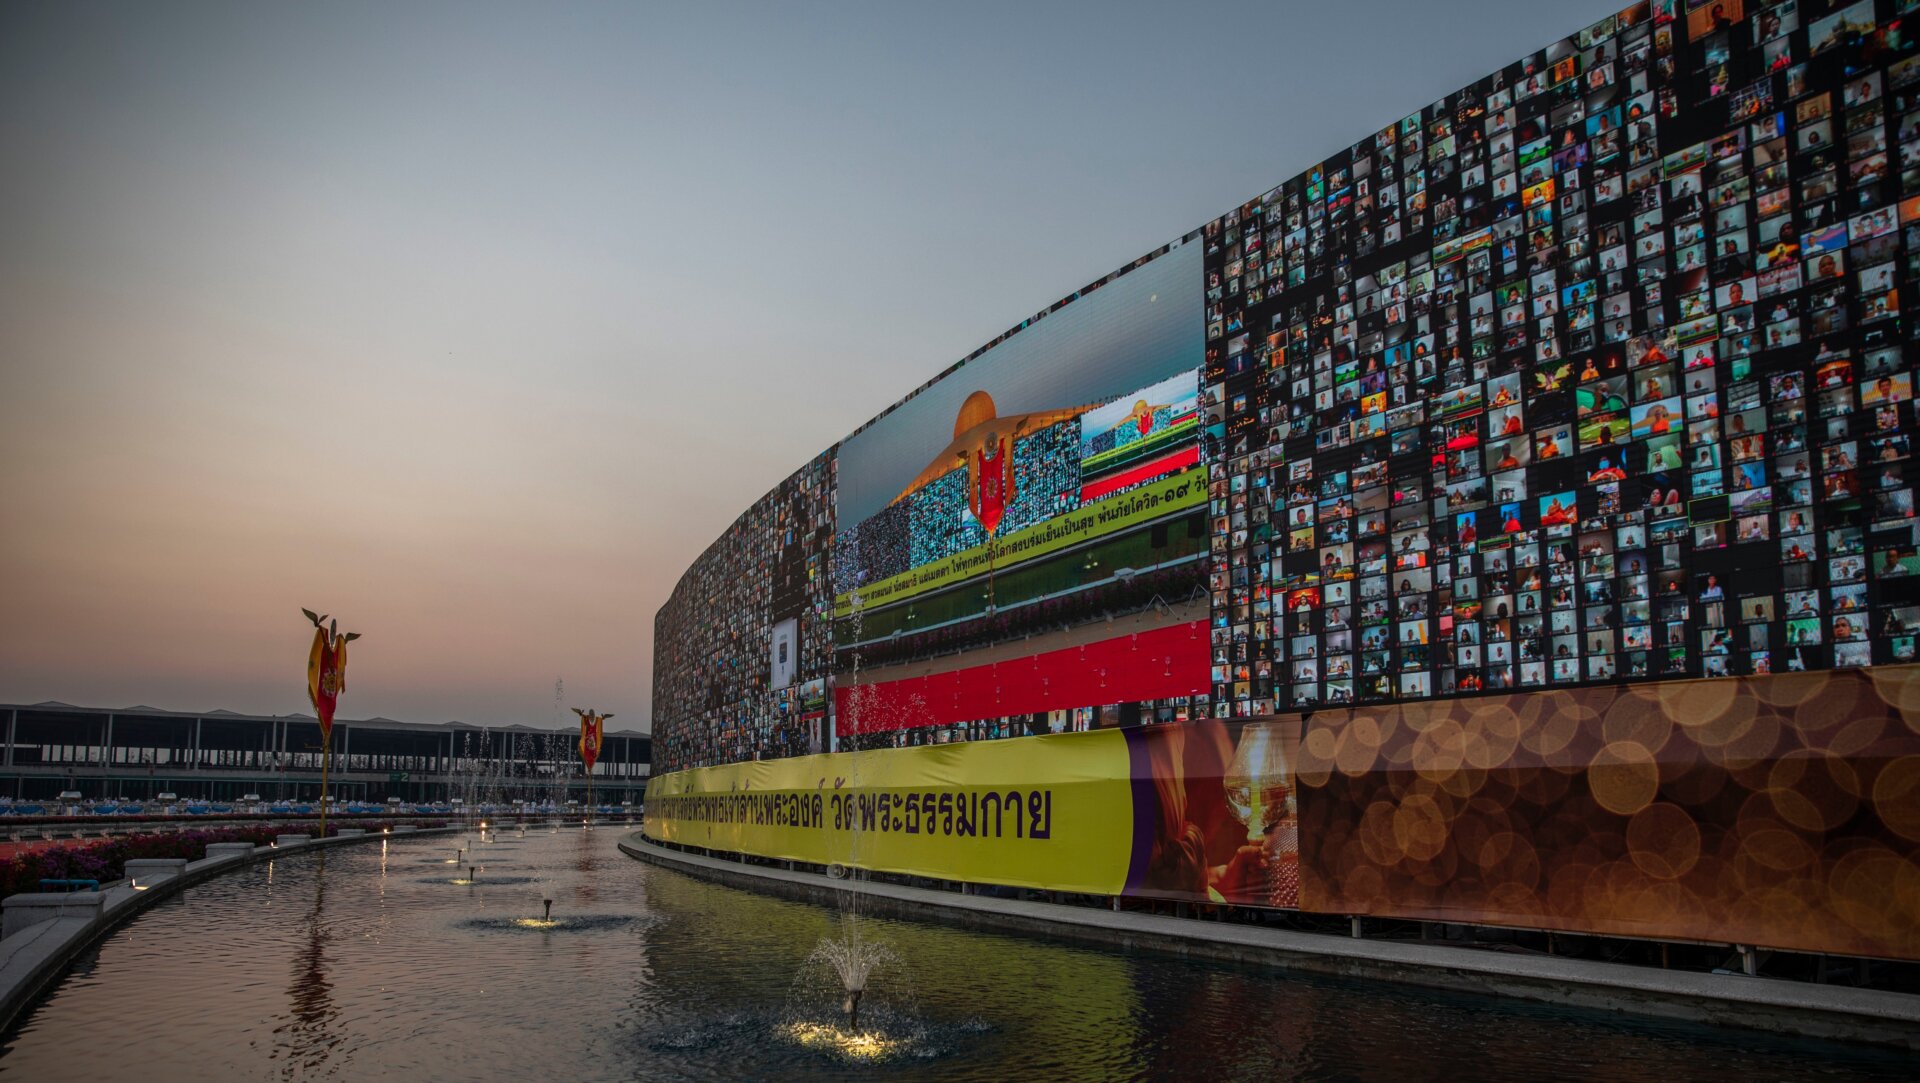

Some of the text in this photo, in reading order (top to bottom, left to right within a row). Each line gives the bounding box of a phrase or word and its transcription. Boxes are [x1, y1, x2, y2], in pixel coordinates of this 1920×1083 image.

[831, 776, 1051, 840] วัดพระธรรมกาย
